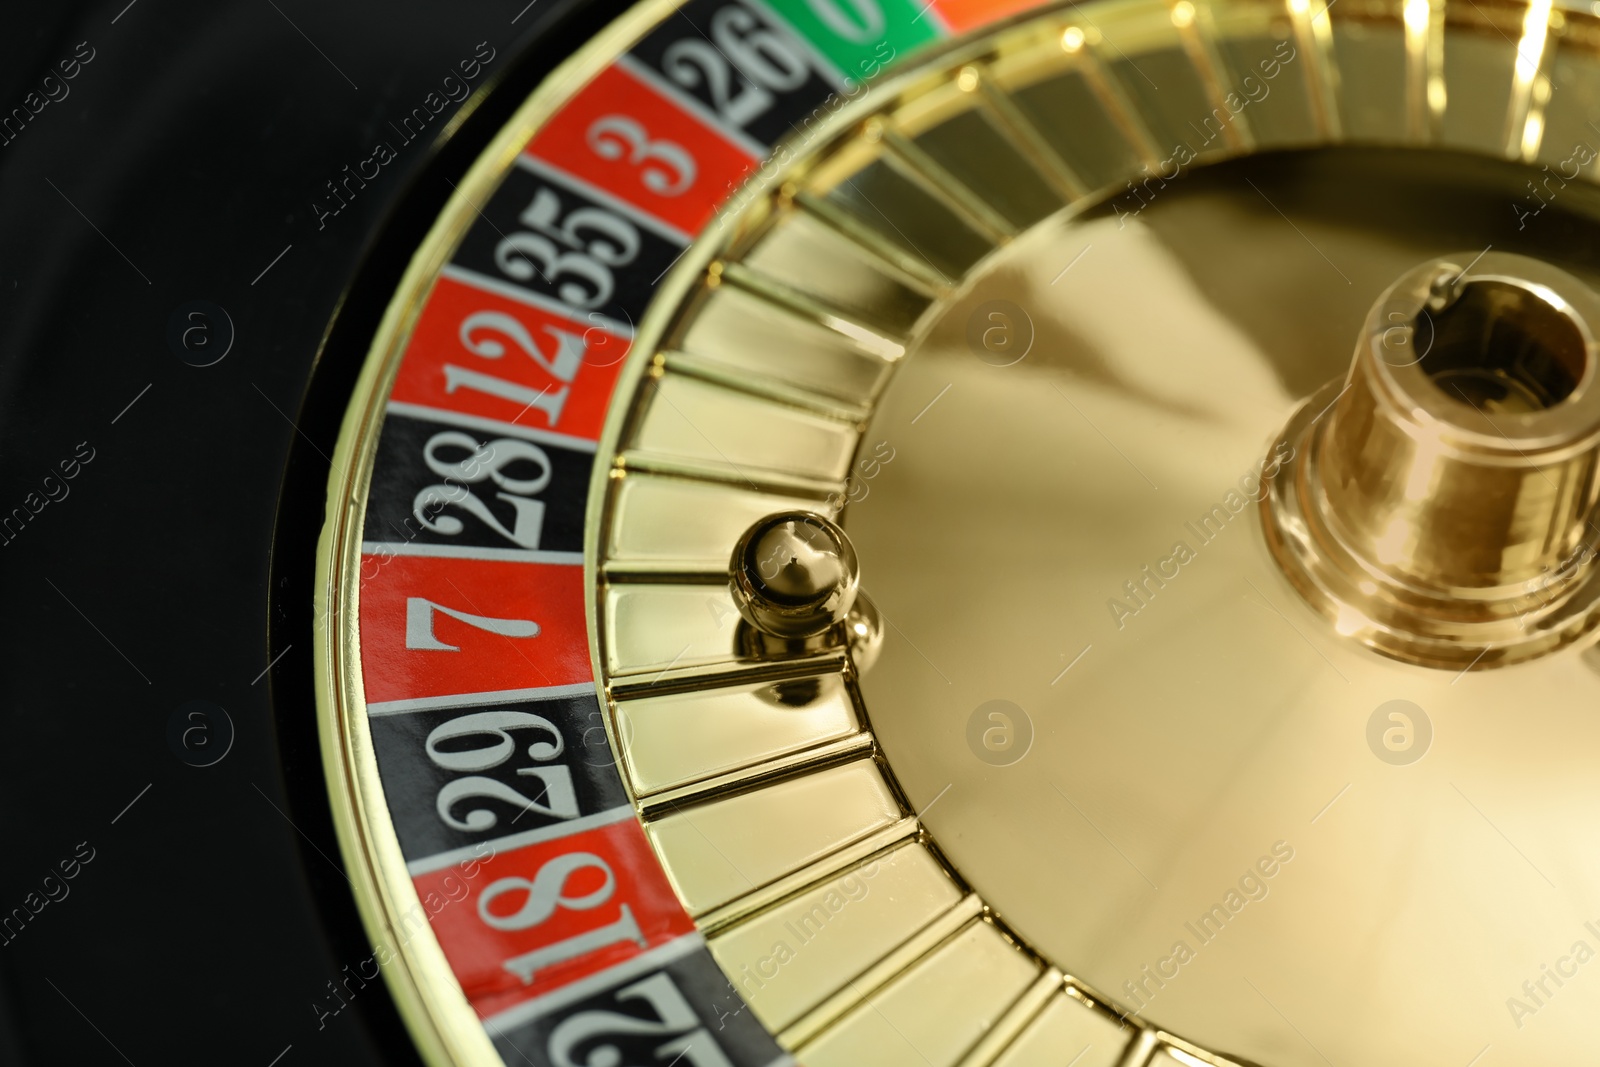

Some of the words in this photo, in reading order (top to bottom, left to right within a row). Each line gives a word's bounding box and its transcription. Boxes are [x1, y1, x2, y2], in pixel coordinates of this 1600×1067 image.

[660, 3, 810, 128] 26
[584, 112, 699, 198] 3
[494, 188, 639, 308] 35
[442, 309, 587, 428] 12
[411, 430, 551, 551] 28
[405, 596, 541, 652] 7
[424, 710, 581, 833] 29
[478, 851, 650, 986] 18
[546, 971, 738, 1067] 2
